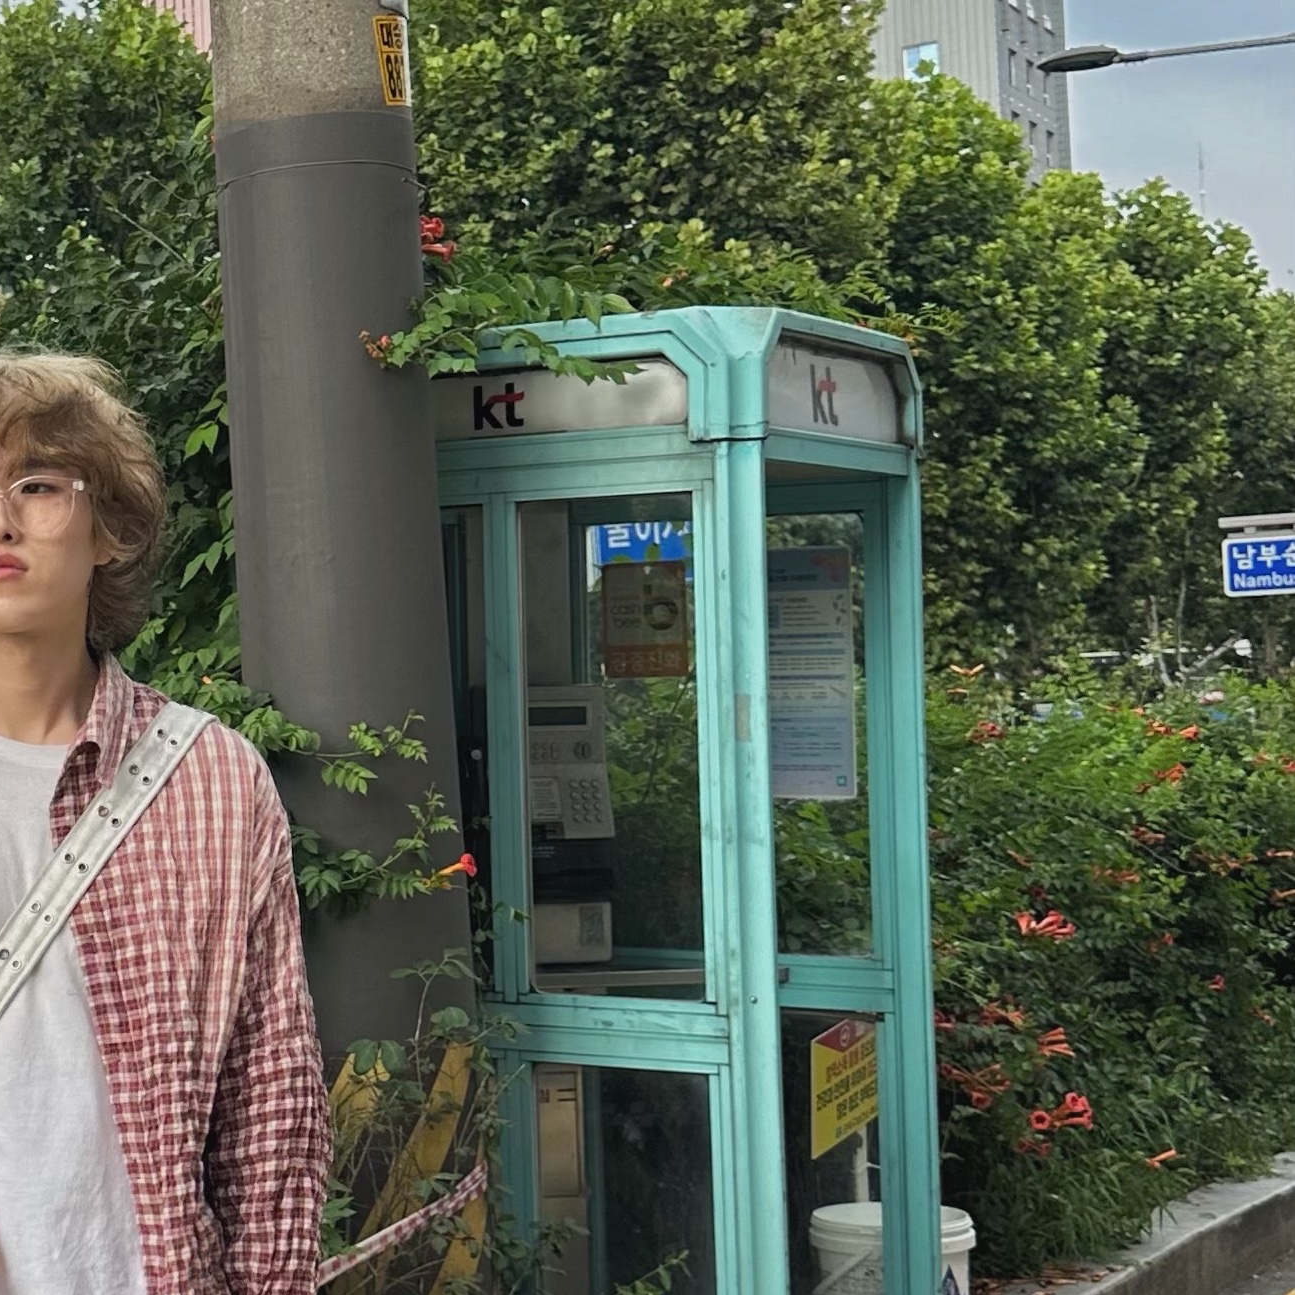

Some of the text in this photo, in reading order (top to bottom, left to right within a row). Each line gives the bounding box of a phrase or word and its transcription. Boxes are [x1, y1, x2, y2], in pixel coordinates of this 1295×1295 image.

[473, 382, 525, 431] kt
[810, 363, 839, 427] kt
[1233, 571, 1295, 589] Nambu
